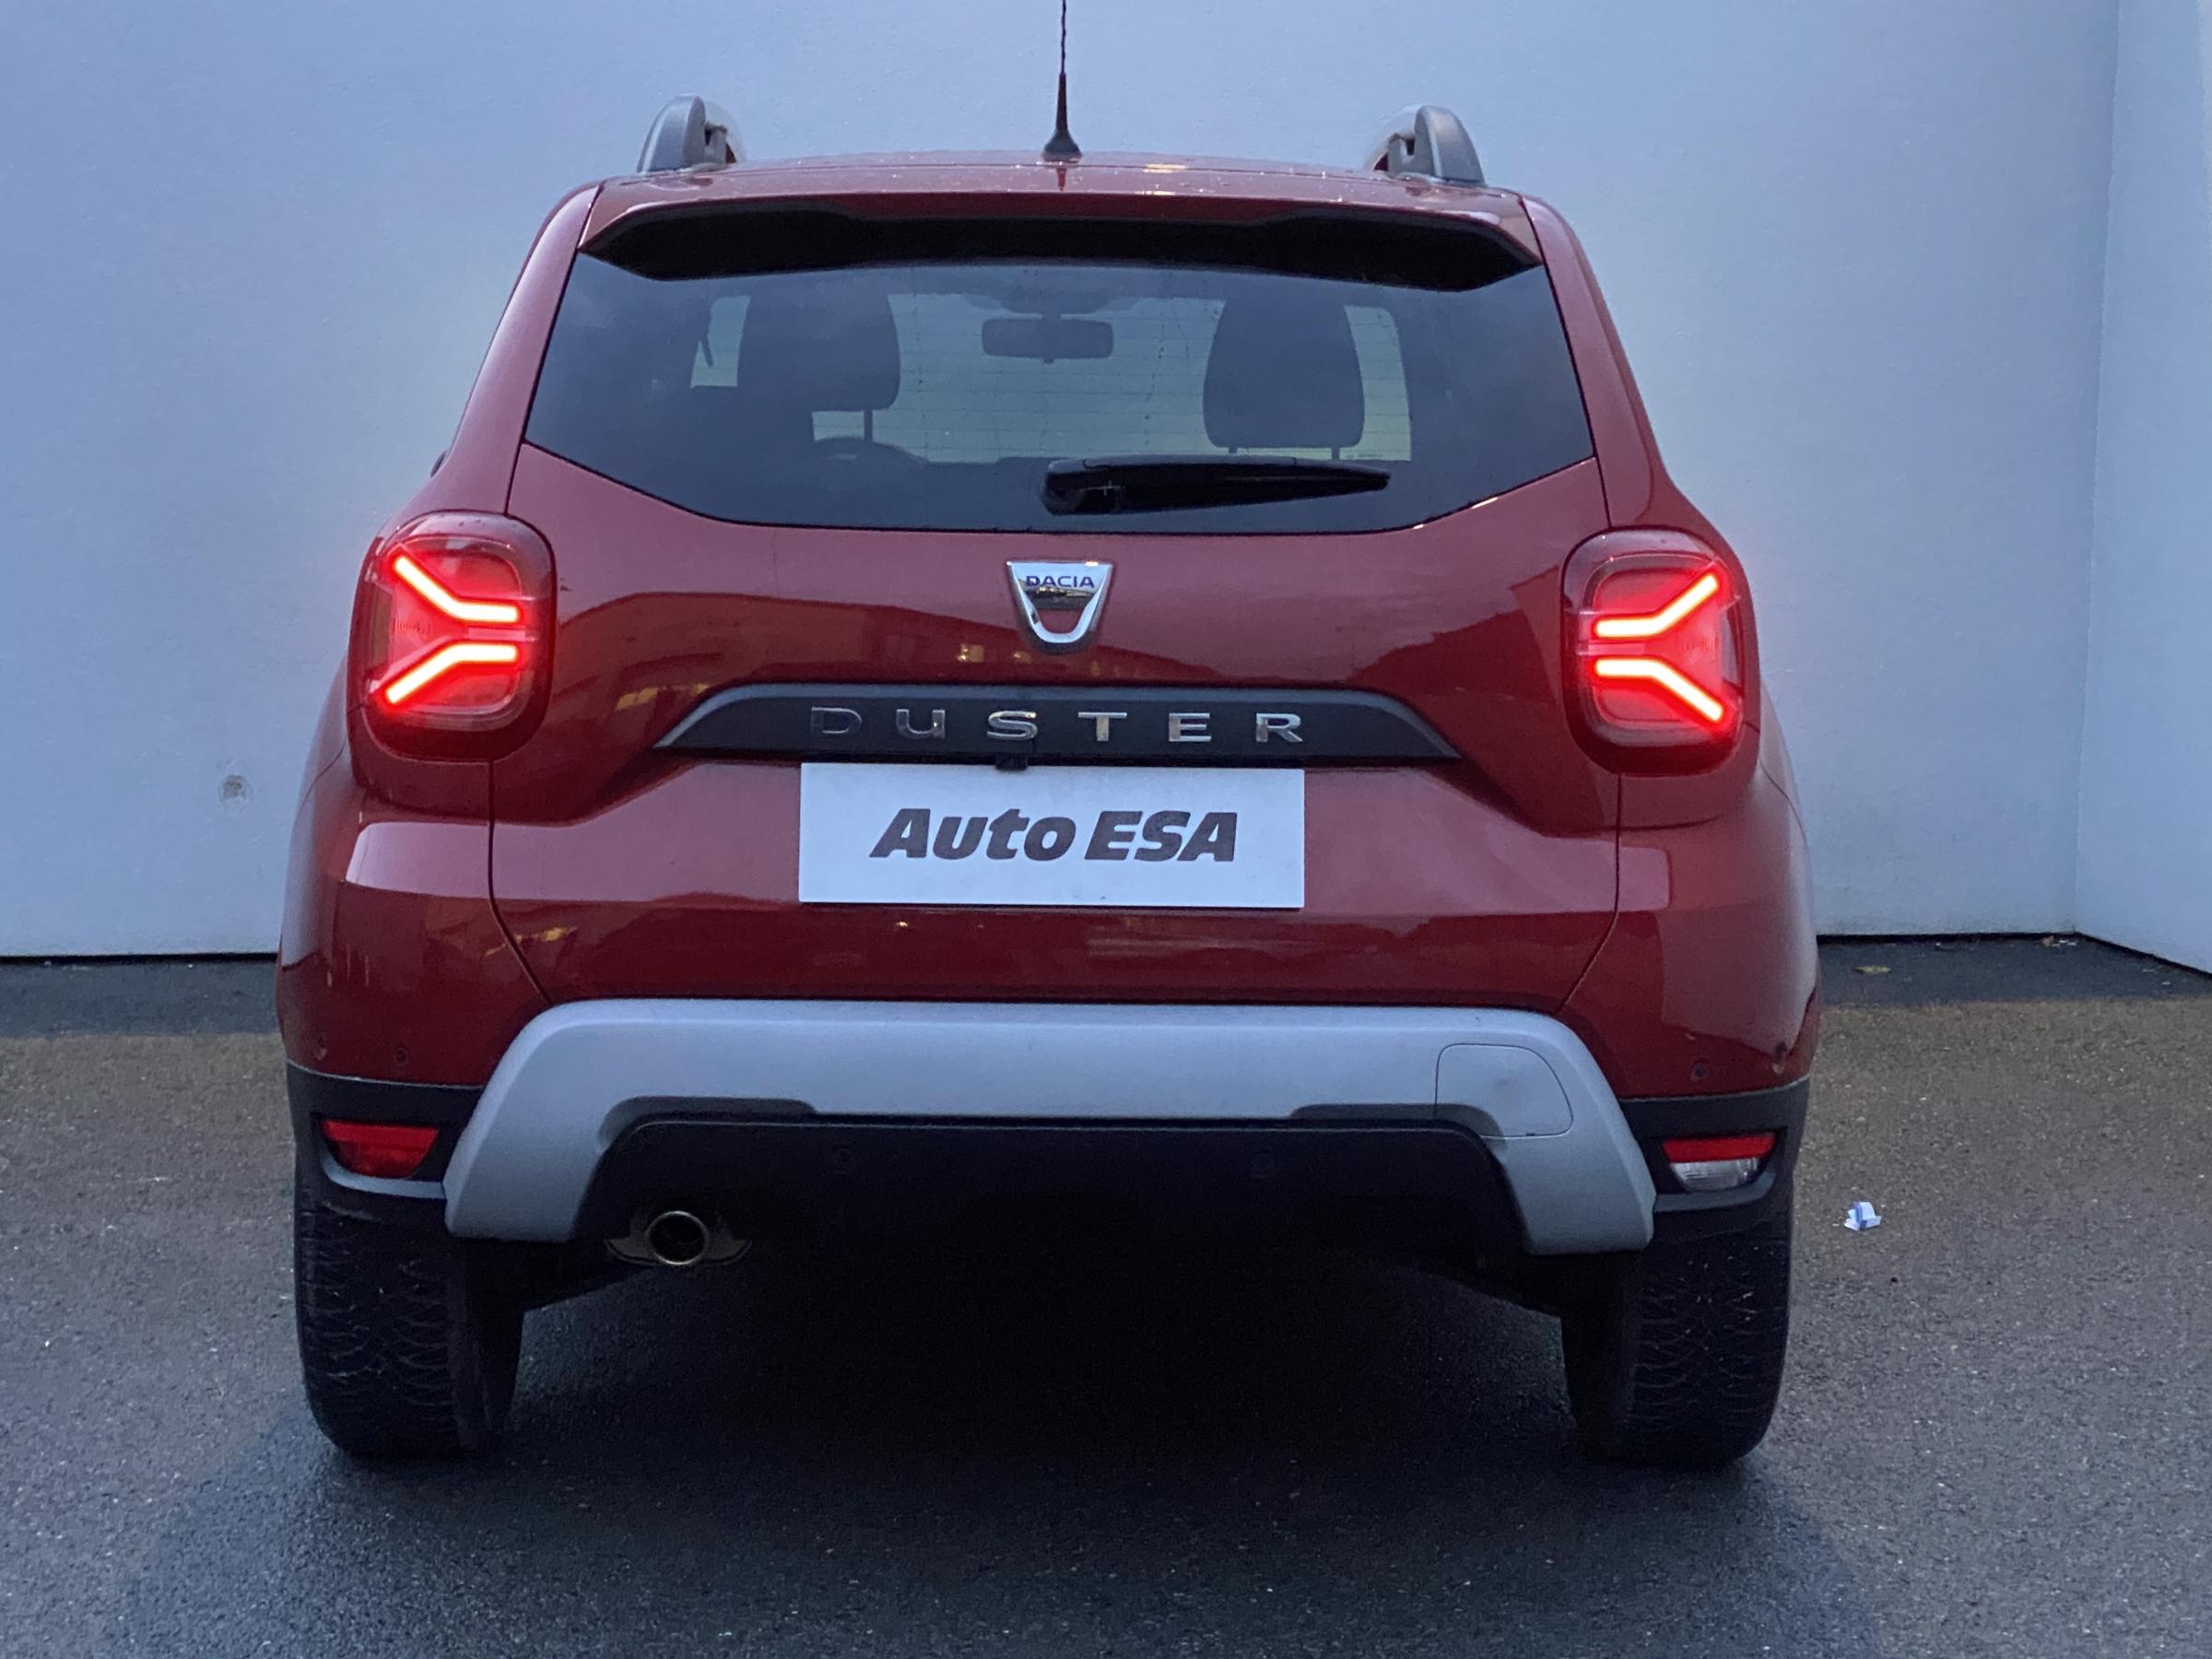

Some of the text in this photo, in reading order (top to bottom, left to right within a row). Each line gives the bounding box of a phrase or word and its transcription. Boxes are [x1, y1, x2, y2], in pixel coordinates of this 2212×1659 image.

[1025, 575, 1095, 588] DACIA
[810, 706, 1304, 743] DUSTER
[869, 807, 1238, 862] Auto ESA
